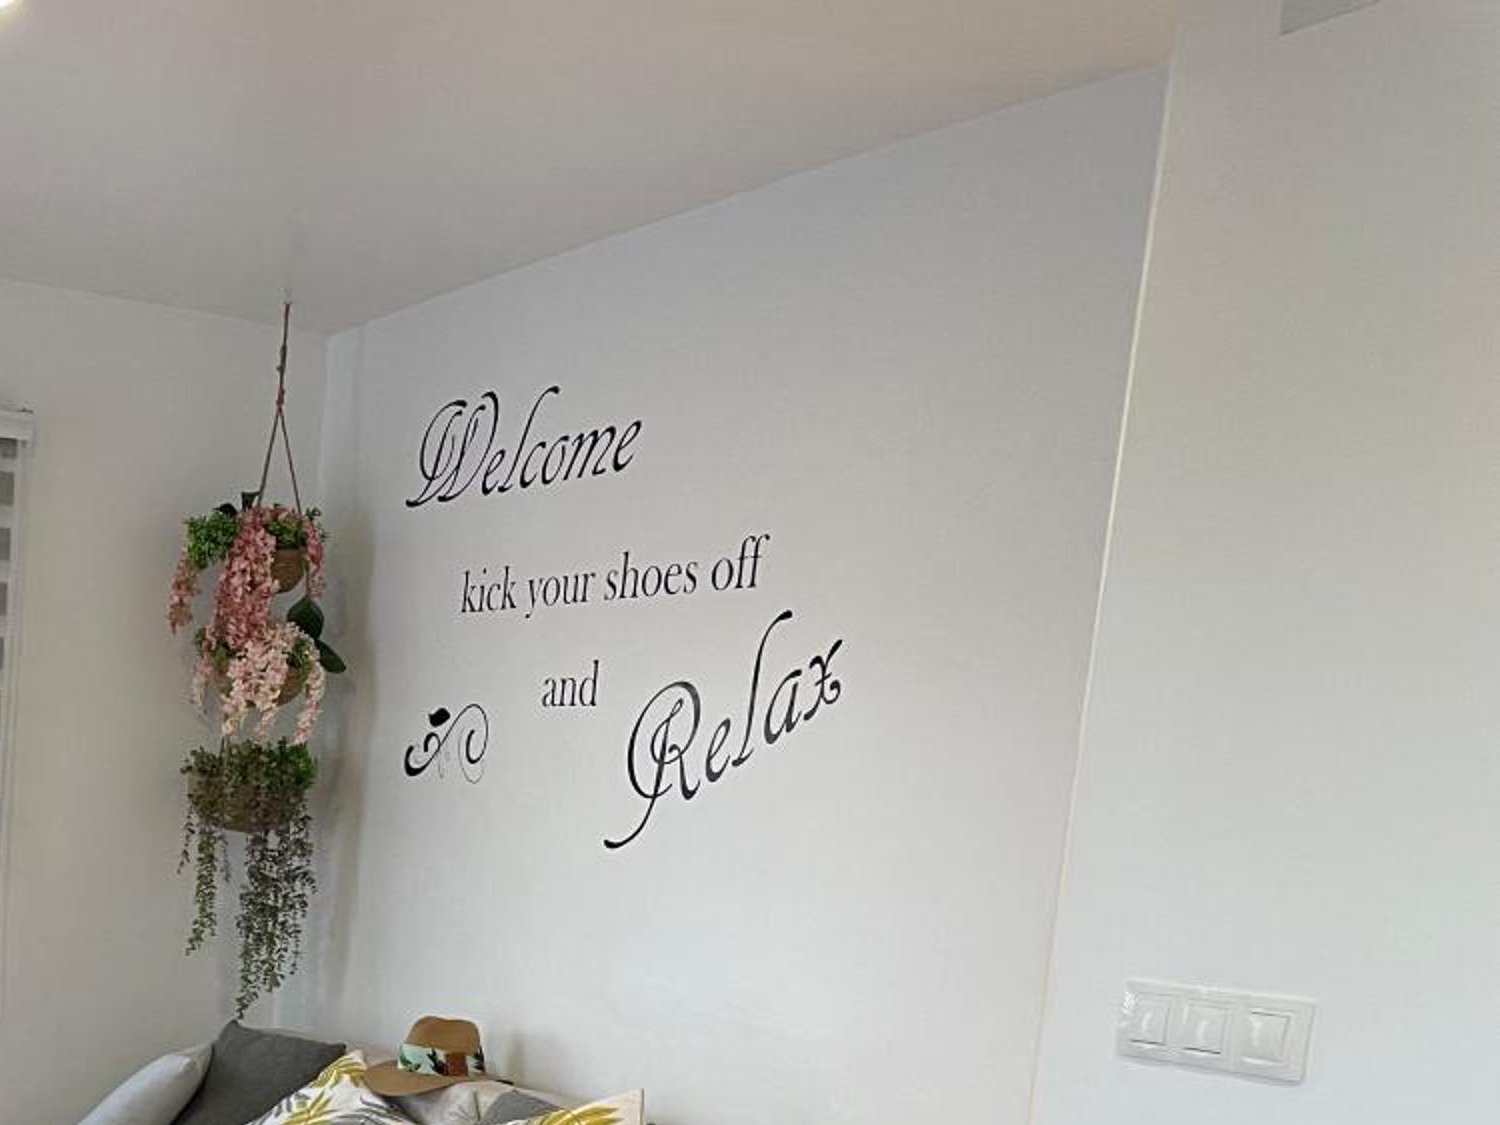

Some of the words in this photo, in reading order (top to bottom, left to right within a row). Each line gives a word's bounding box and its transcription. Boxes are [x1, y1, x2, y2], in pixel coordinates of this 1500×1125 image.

[405, 385, 642, 509] Welcome
[460, 564, 517, 613] kick
[524, 571, 597, 619] your
[603, 551, 699, 601] shoes
[710, 533, 771, 591] off
[541, 659, 599, 707] and
[603, 609, 844, 849] Relax
